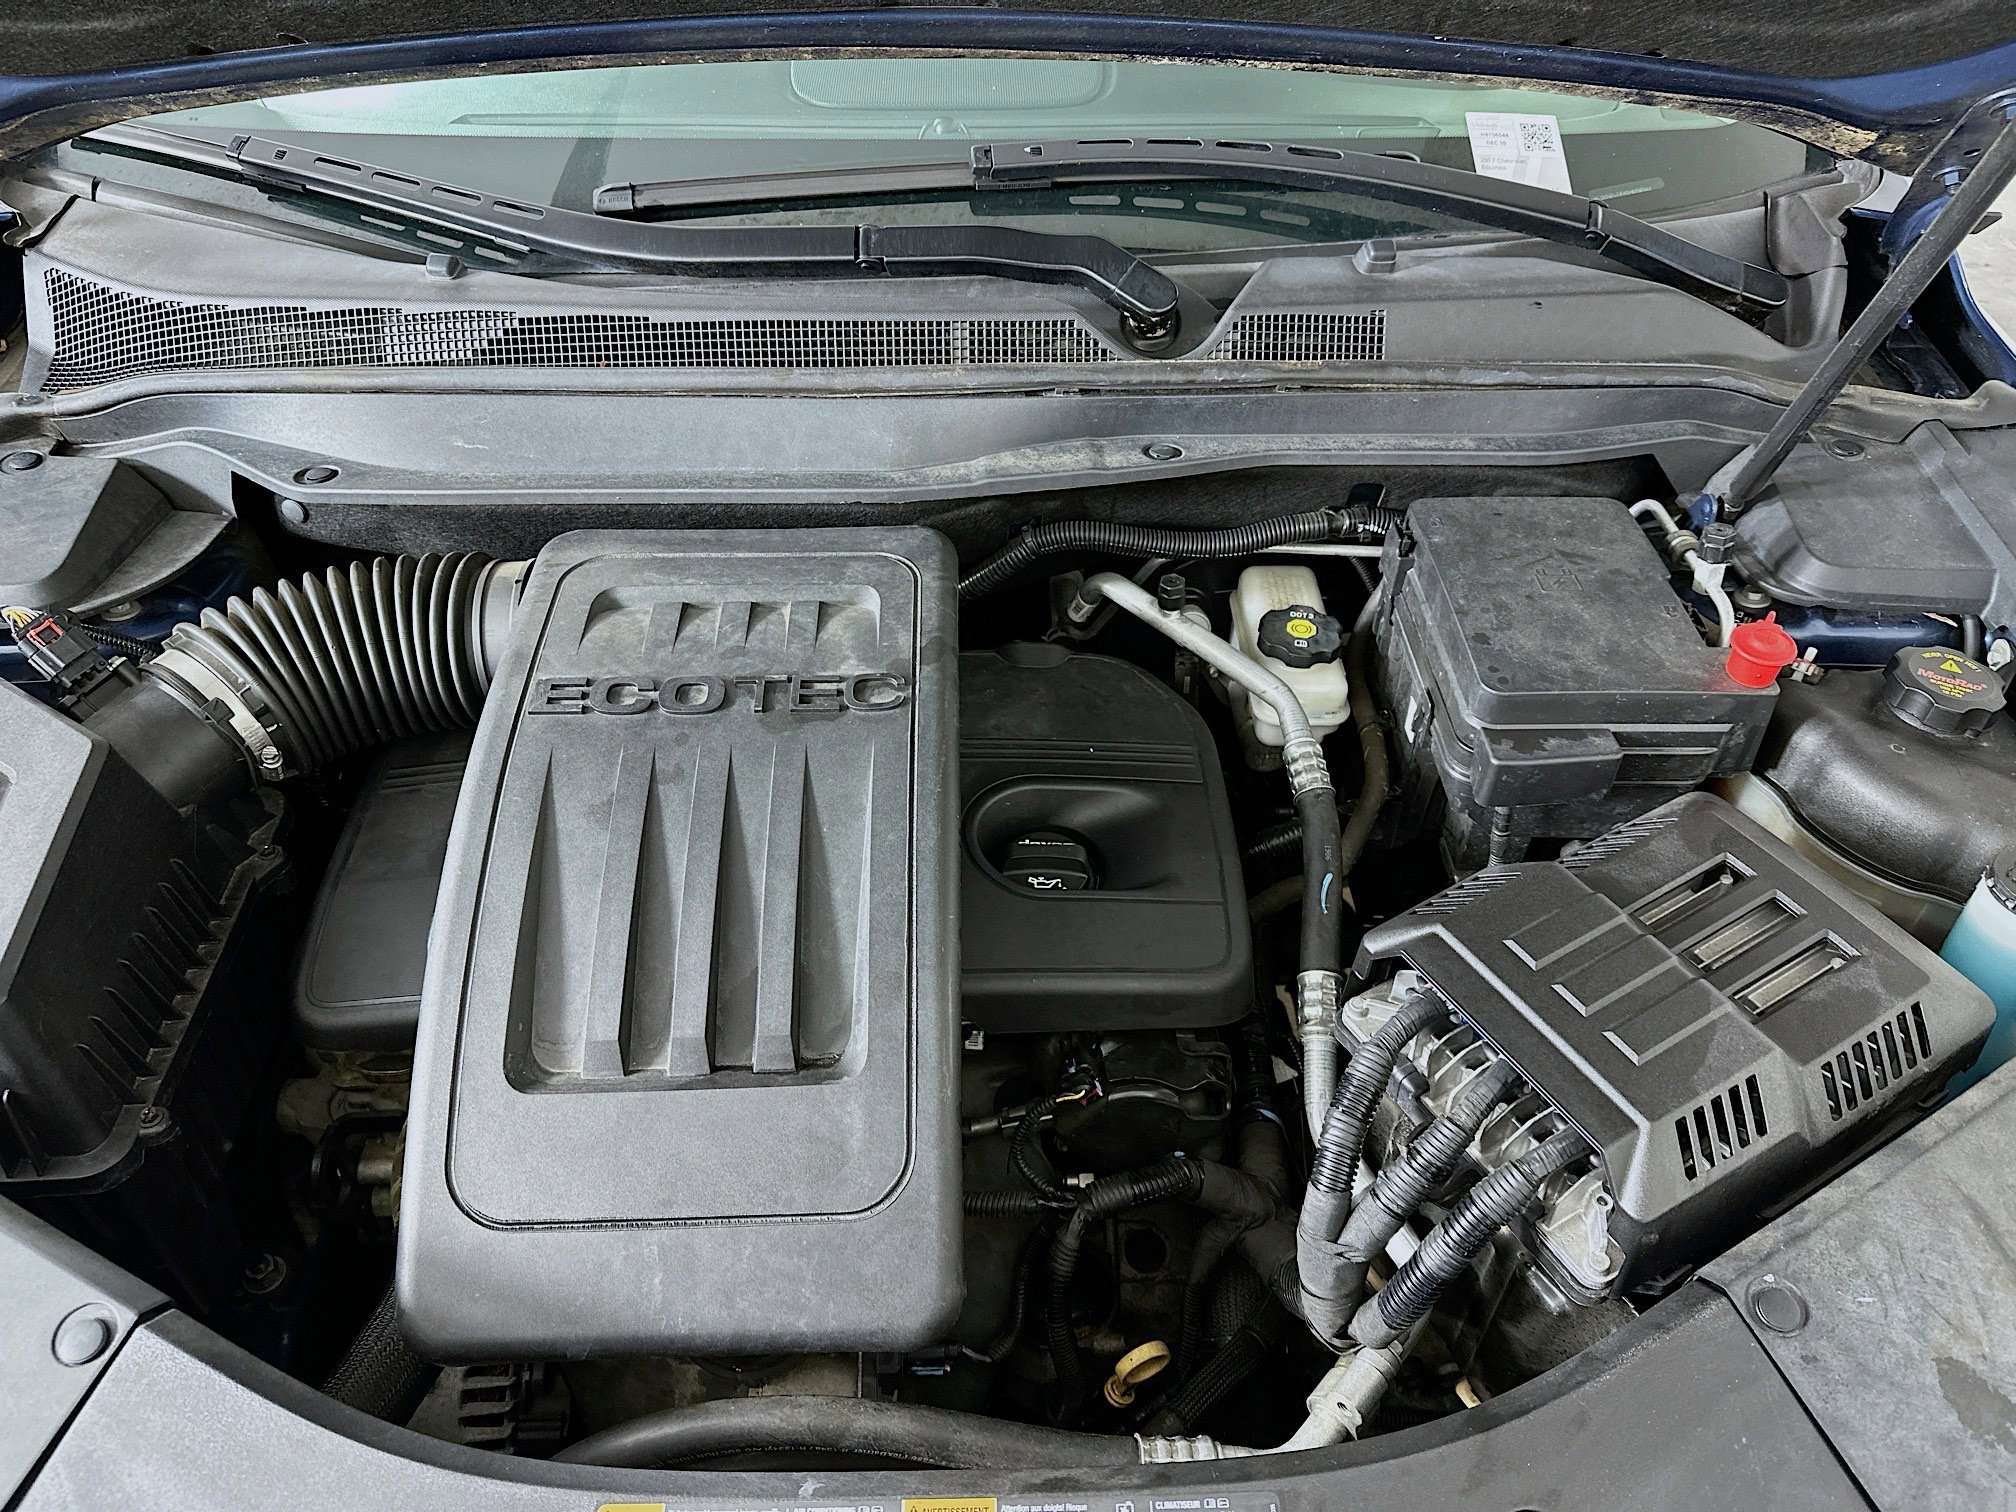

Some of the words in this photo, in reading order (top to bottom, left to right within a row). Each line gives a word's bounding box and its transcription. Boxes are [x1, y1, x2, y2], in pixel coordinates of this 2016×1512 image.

[1289, 611, 1307, 619] DOT
[528, 673, 907, 715] ECOTEC
[1155, 1500, 1201, 1509] CLIMATISEUR
